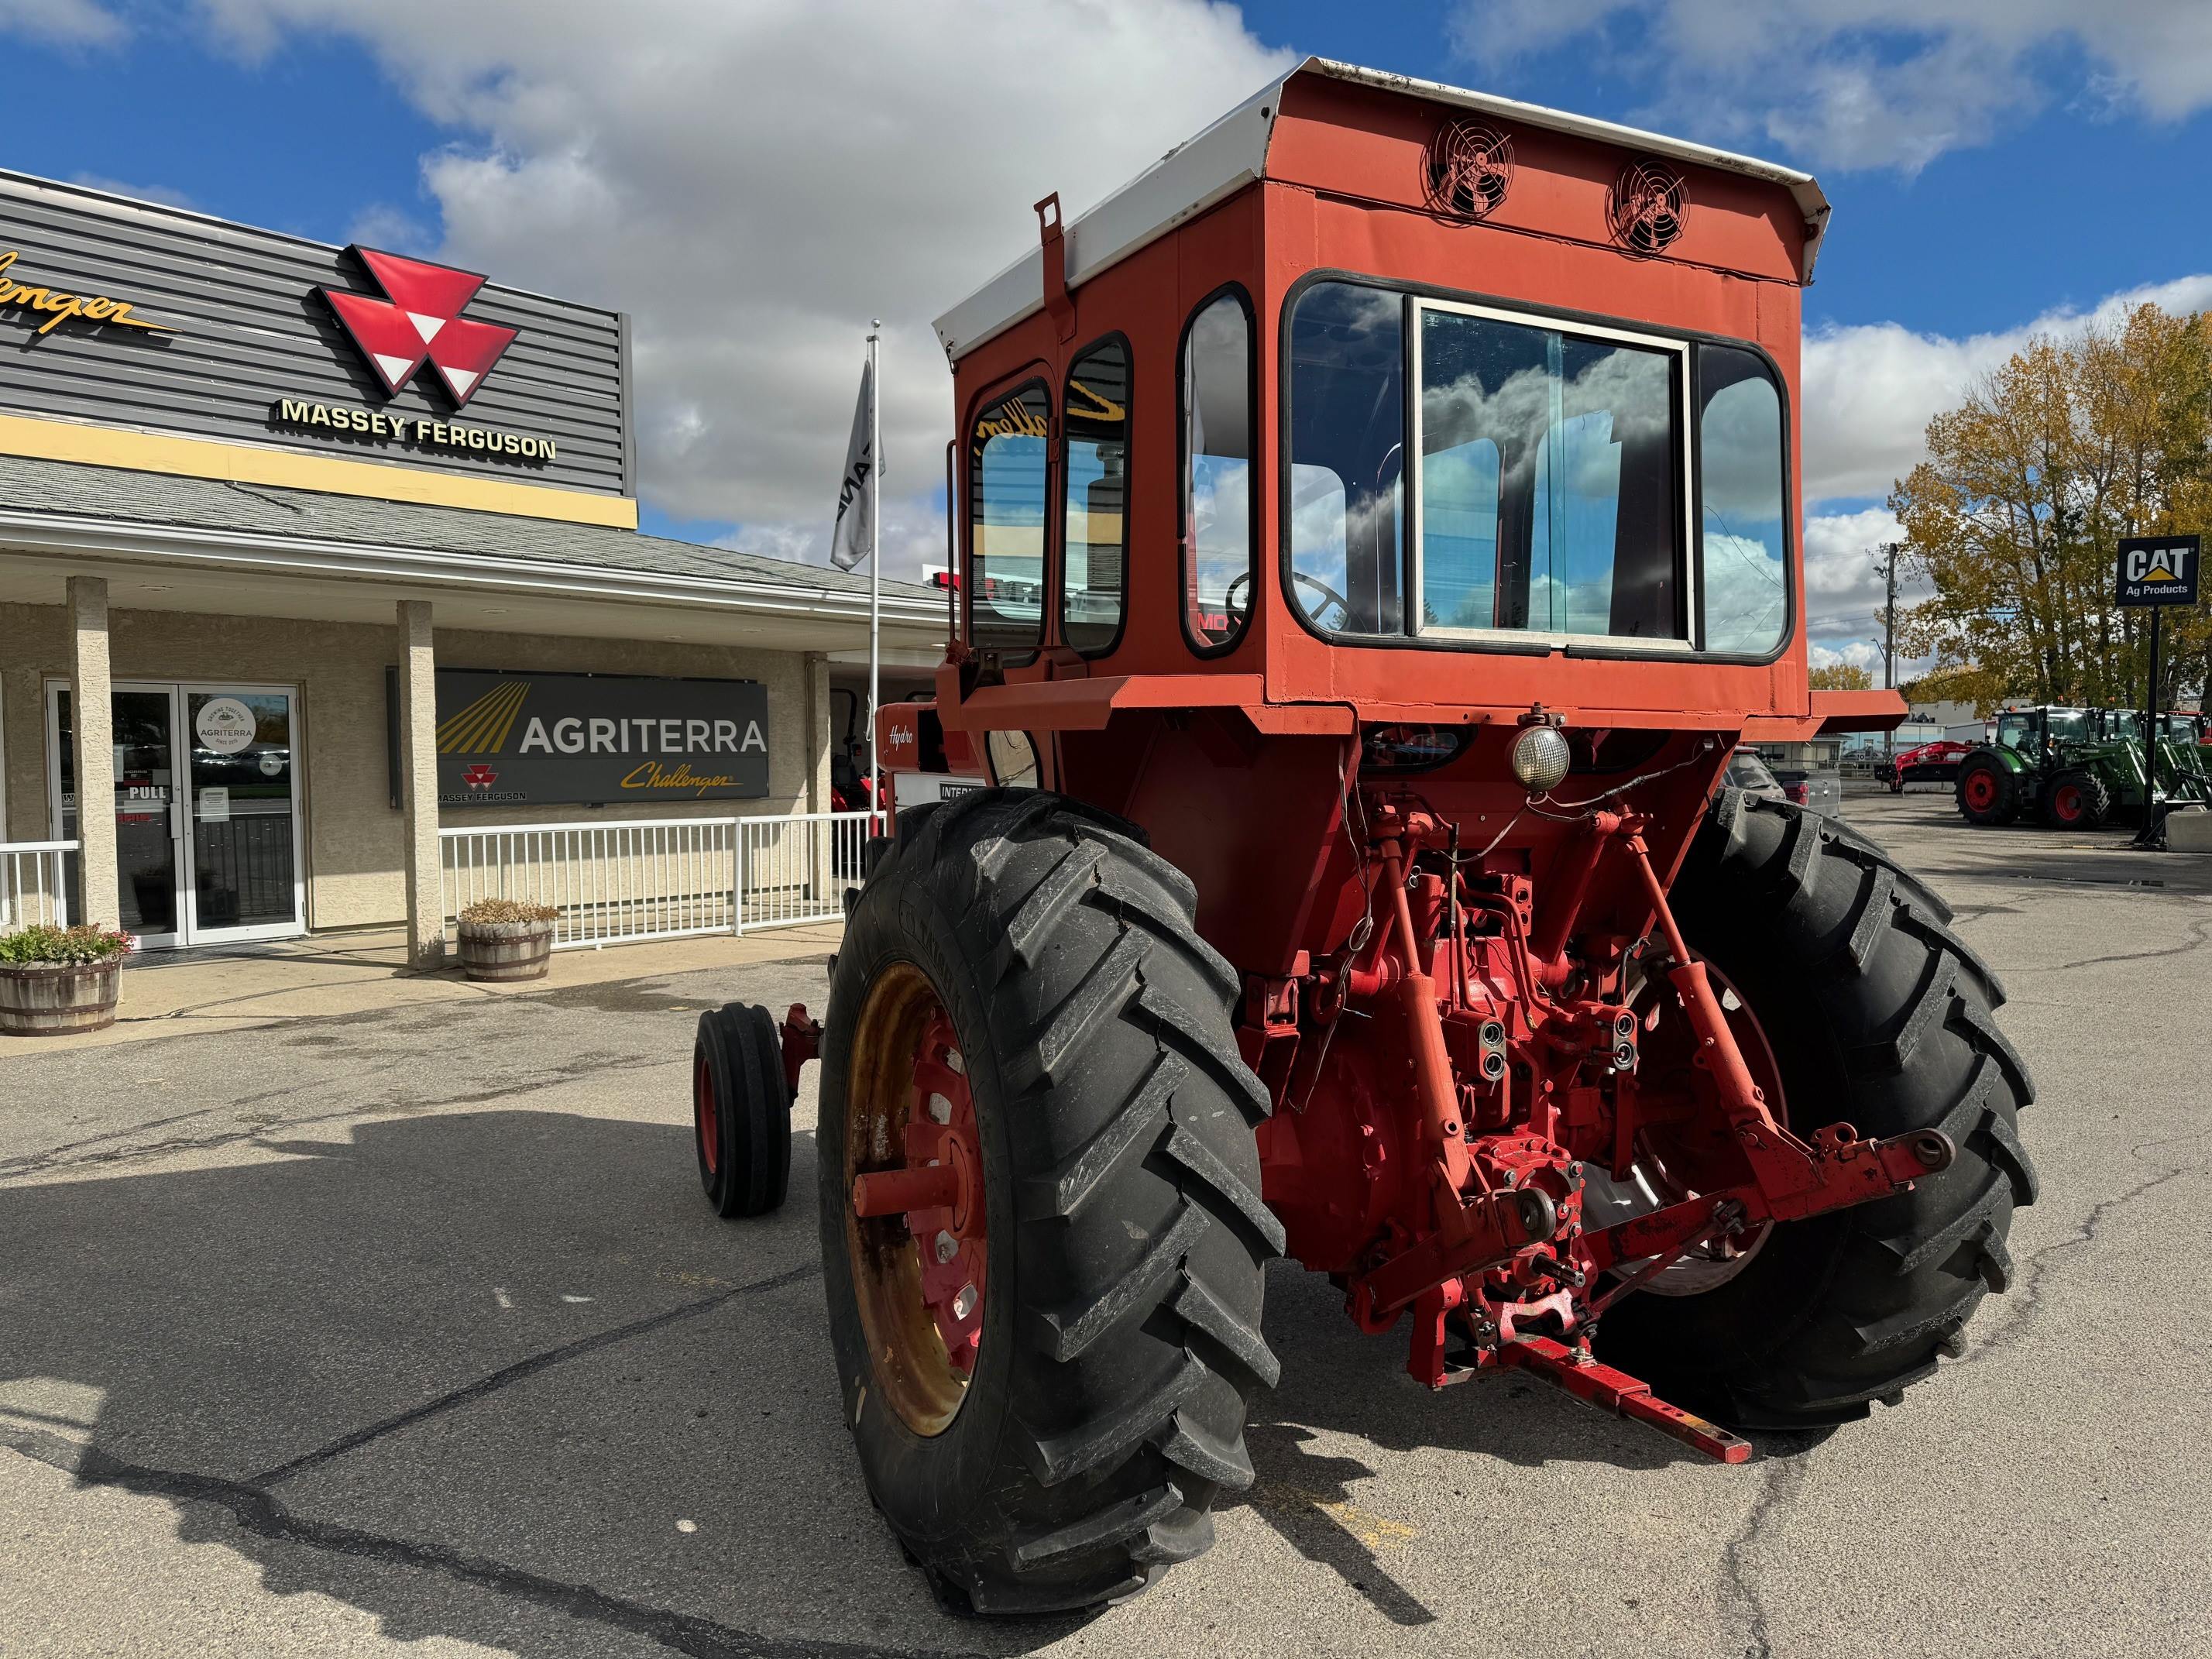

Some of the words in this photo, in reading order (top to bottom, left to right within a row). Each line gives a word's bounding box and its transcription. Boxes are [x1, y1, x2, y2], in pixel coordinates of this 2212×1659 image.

[281, 398, 405, 437] MASSEY
[417, 420, 557, 460] FERGUSON
[2126, 548, 2190, 582] CAT
[2126, 586, 2140, 597] Ag
[2143, 585, 2188, 595] Products
[519, 717, 768, 754] AGRITERRA
[889, 725, 913, 751] Hydro
[129, 786, 167, 799] PULL
[620, 761, 744, 797] Challenger
[476, 792, 527, 801] FERGUSON
